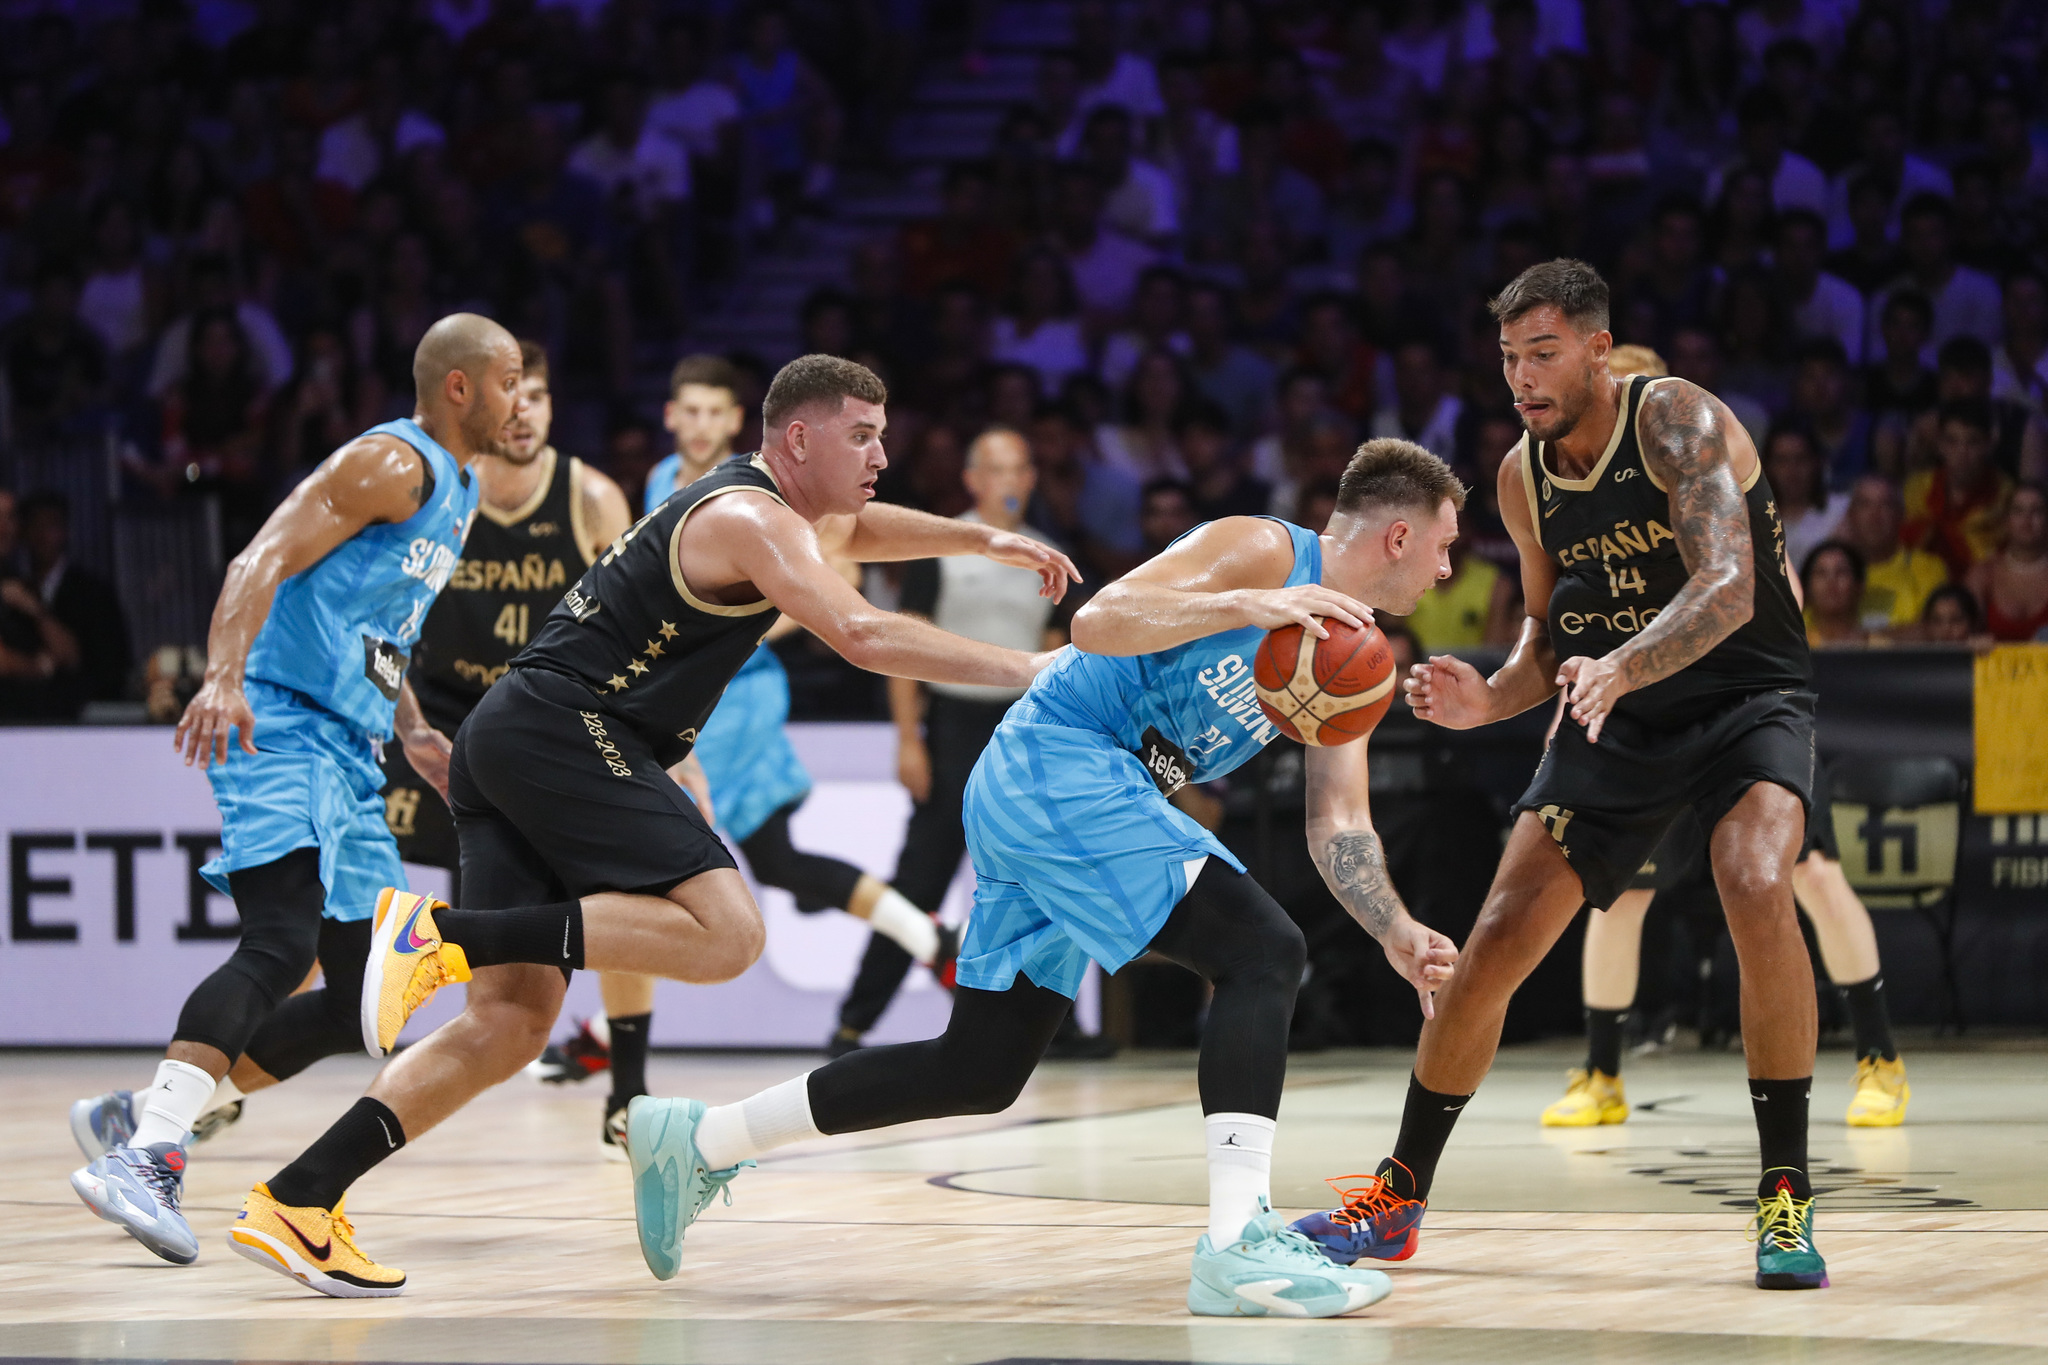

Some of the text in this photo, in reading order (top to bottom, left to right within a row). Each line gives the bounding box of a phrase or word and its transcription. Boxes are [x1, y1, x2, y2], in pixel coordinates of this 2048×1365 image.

[451, 553, 566, 591] ESPAÑA
[1603, 561, 1647, 598] 14
[494, 603, 529, 646] 41
